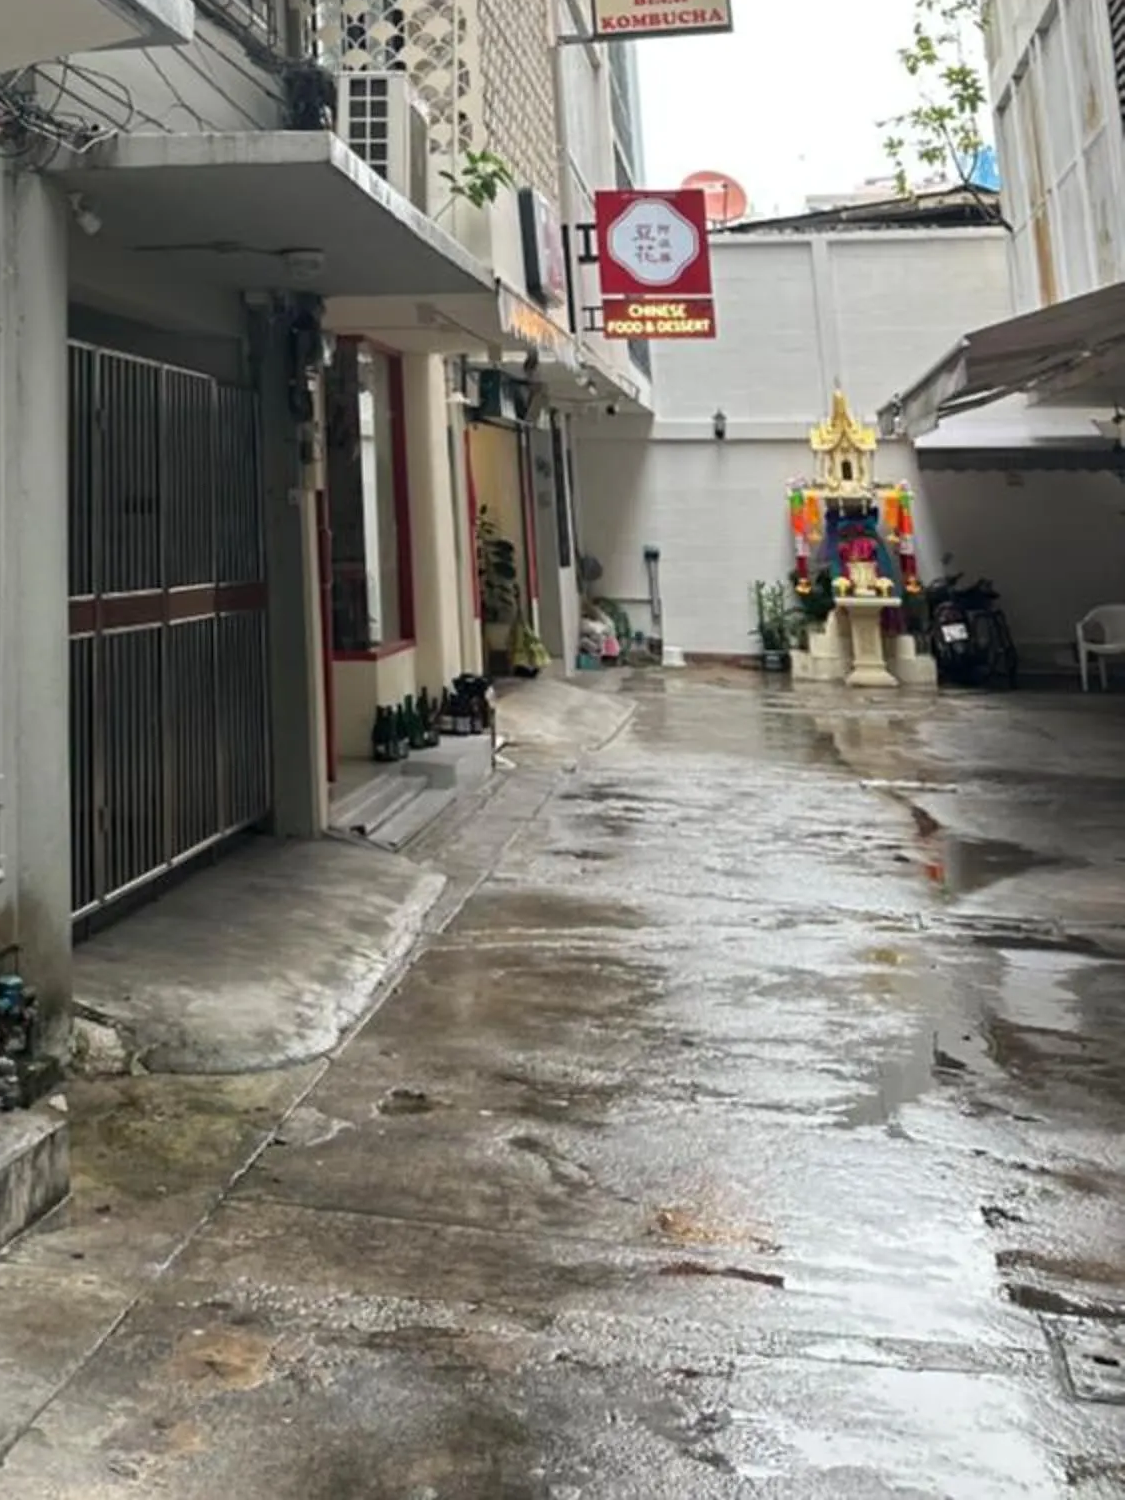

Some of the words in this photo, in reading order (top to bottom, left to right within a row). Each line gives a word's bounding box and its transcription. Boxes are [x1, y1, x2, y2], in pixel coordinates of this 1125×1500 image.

[601, 8, 723, 30] KOMBUCHA
[628, 303, 687, 318] CHINESE
[606, 320, 644, 334] FOOD
[656, 318, 711, 333] DESSERT
